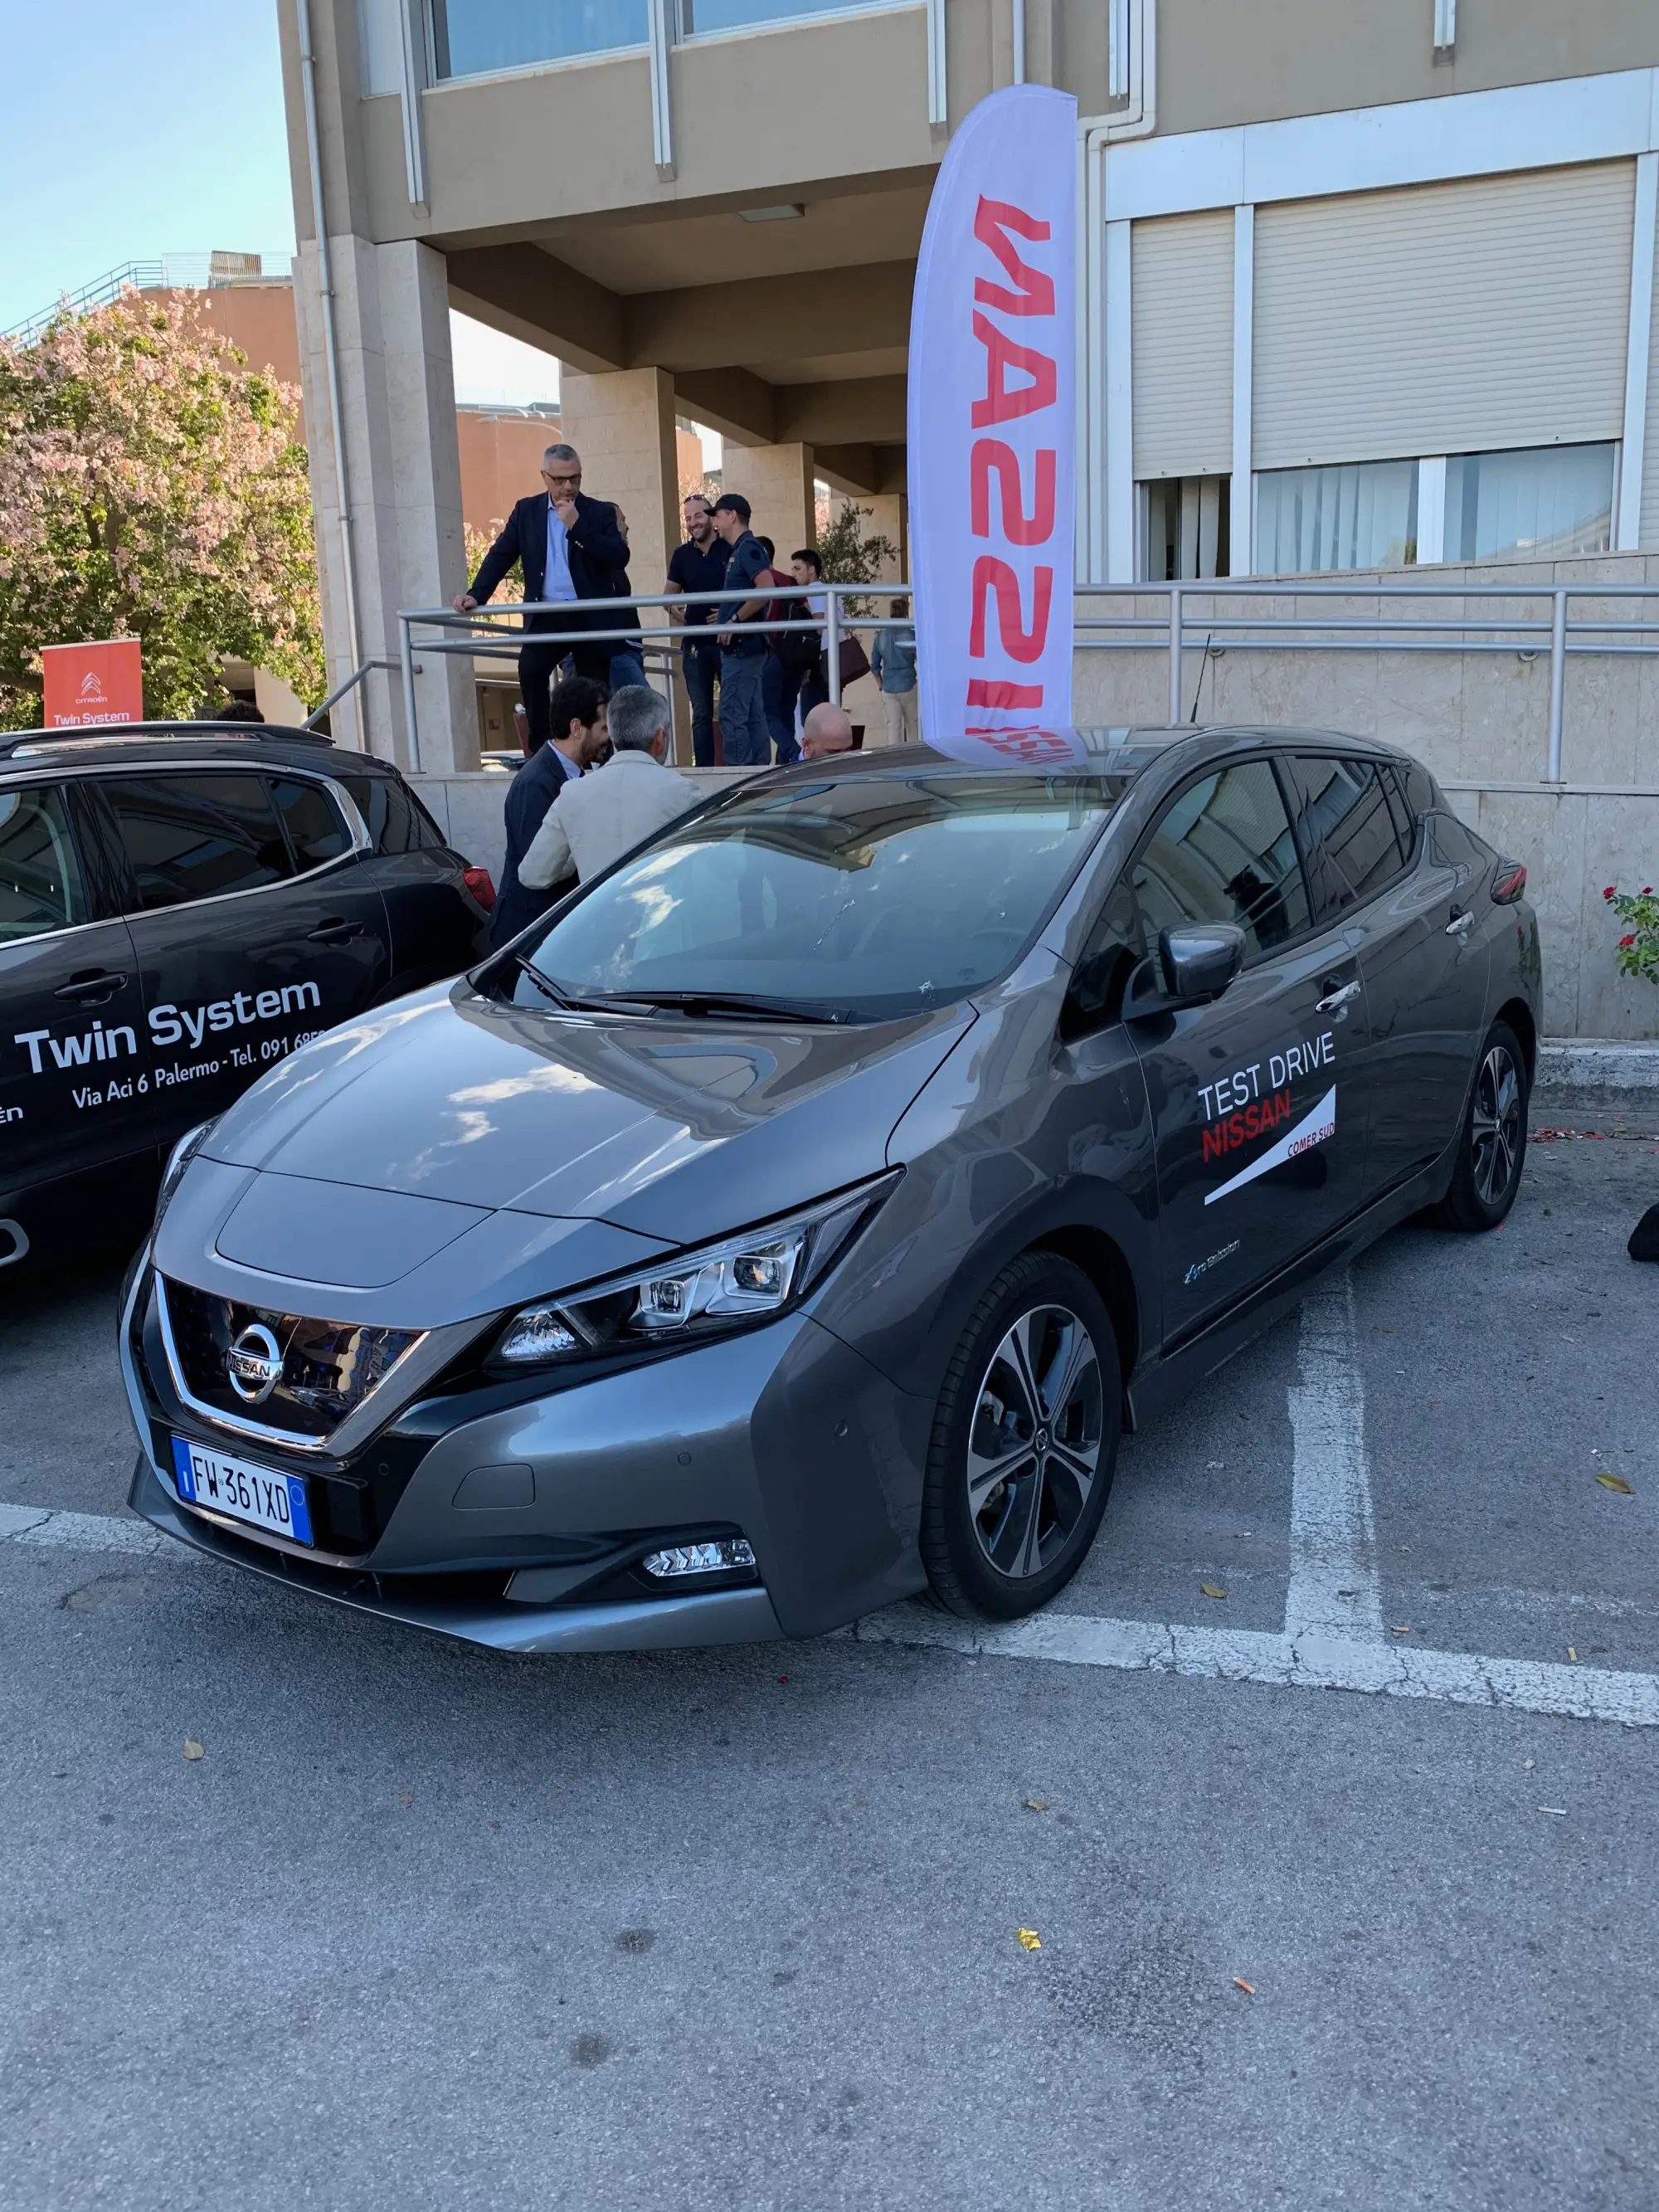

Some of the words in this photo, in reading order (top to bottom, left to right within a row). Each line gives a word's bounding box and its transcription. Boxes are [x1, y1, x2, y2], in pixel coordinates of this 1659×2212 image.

[54, 714, 80, 725] Twin
[82, 712, 129, 724] System
[14, 1021, 137, 1074] Twin
[148, 981, 321, 1049] System
[72, 1088, 102, 1108] Via
[107, 1078, 133, 1101] Aci
[137, 1074, 148, 1094] 6
[154, 1061, 219, 1089] Palermo
[230, 1044, 257, 1067] Tel.
[260, 1037, 289, 1060] 091
[1198, 1064, 1260, 1121] TEST
[1269, 1031, 1335, 1089] DRIVE
[1203, 1089, 1291, 1163] NISSAN
[1287, 1133, 1316, 1157] COMER
[1319, 1122, 1335, 1141] SUD
